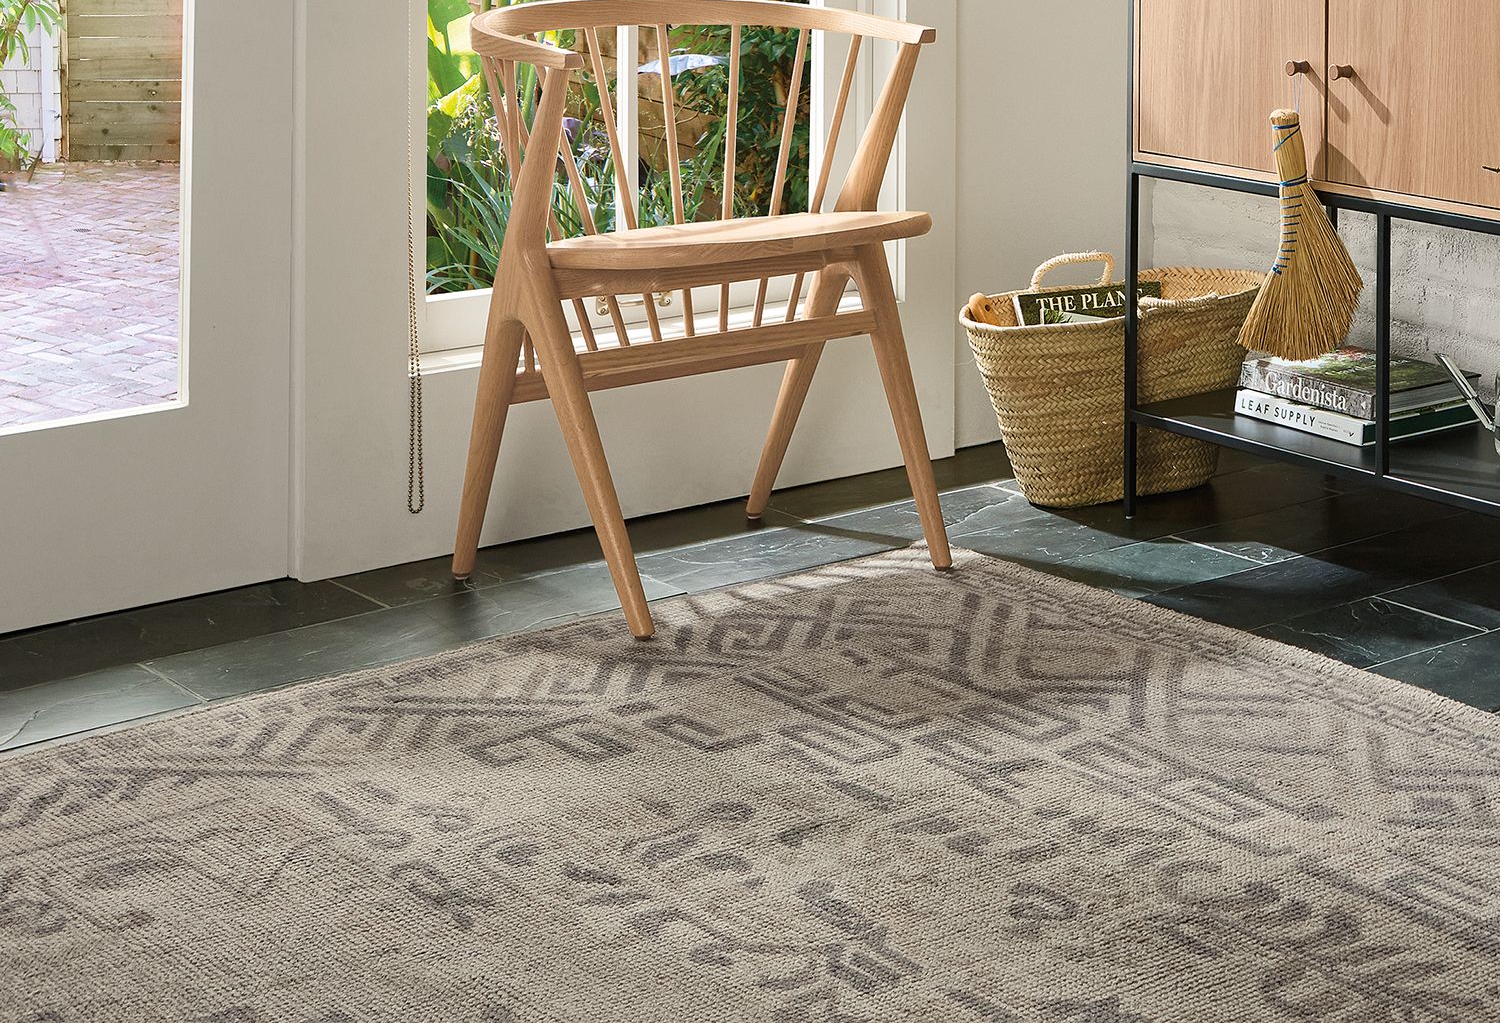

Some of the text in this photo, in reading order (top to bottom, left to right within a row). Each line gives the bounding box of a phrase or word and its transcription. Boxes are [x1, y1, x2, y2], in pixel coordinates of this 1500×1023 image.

[1035, 295, 1077, 313] THE
[1265, 371, 1348, 411] Gardenista
[1241, 397, 1270, 415] LEAF
[1273, 406, 1316, 427] SUPPLY
